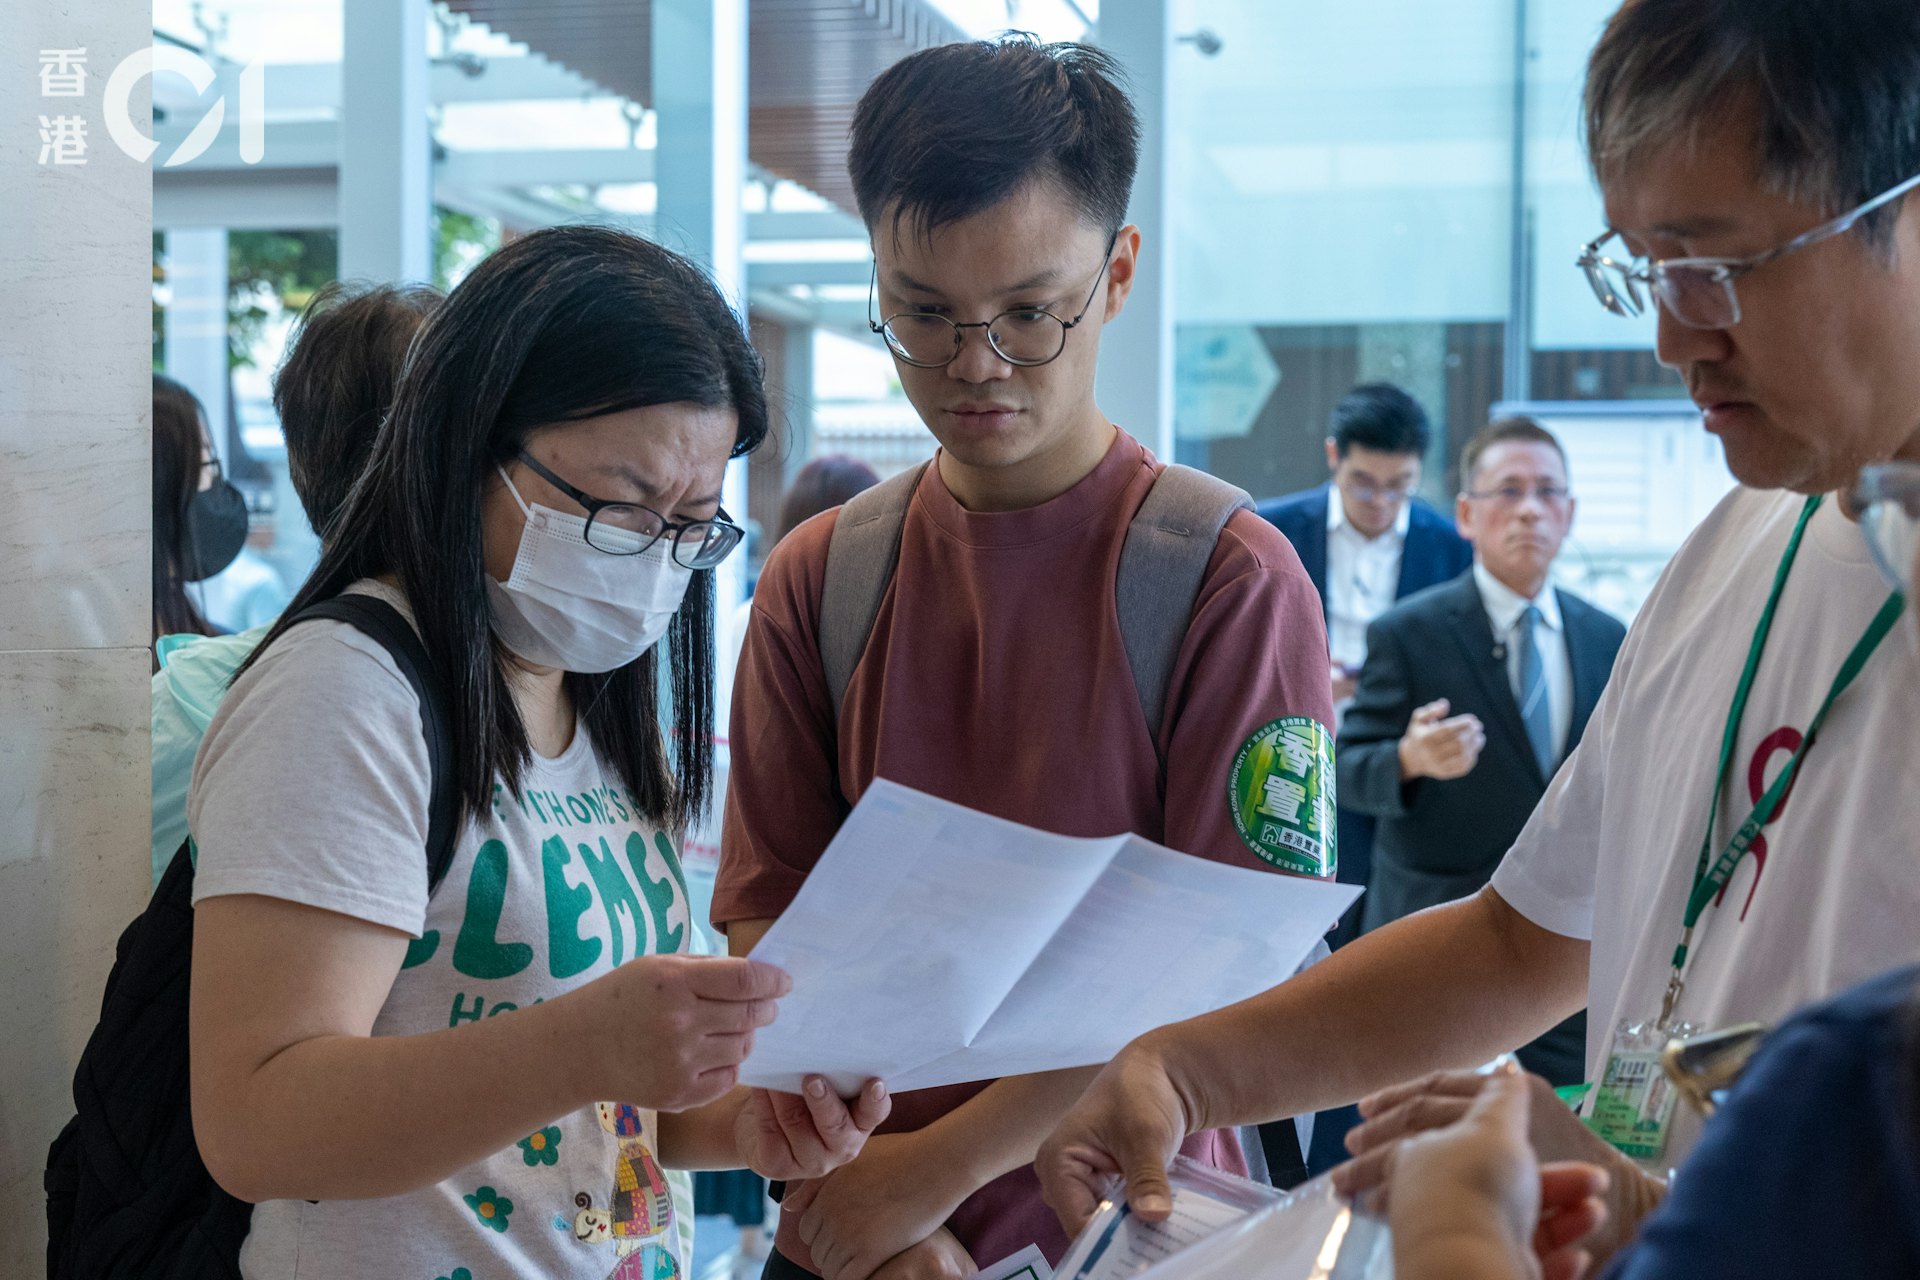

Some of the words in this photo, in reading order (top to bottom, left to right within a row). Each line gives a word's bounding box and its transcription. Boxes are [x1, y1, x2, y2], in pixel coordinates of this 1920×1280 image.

[1230, 748, 1248, 789] PROPERTY
[1230, 789, 1239, 812] KONG
[1233, 812, 1246, 834] HONG
[401, 831, 691, 979] LEME
